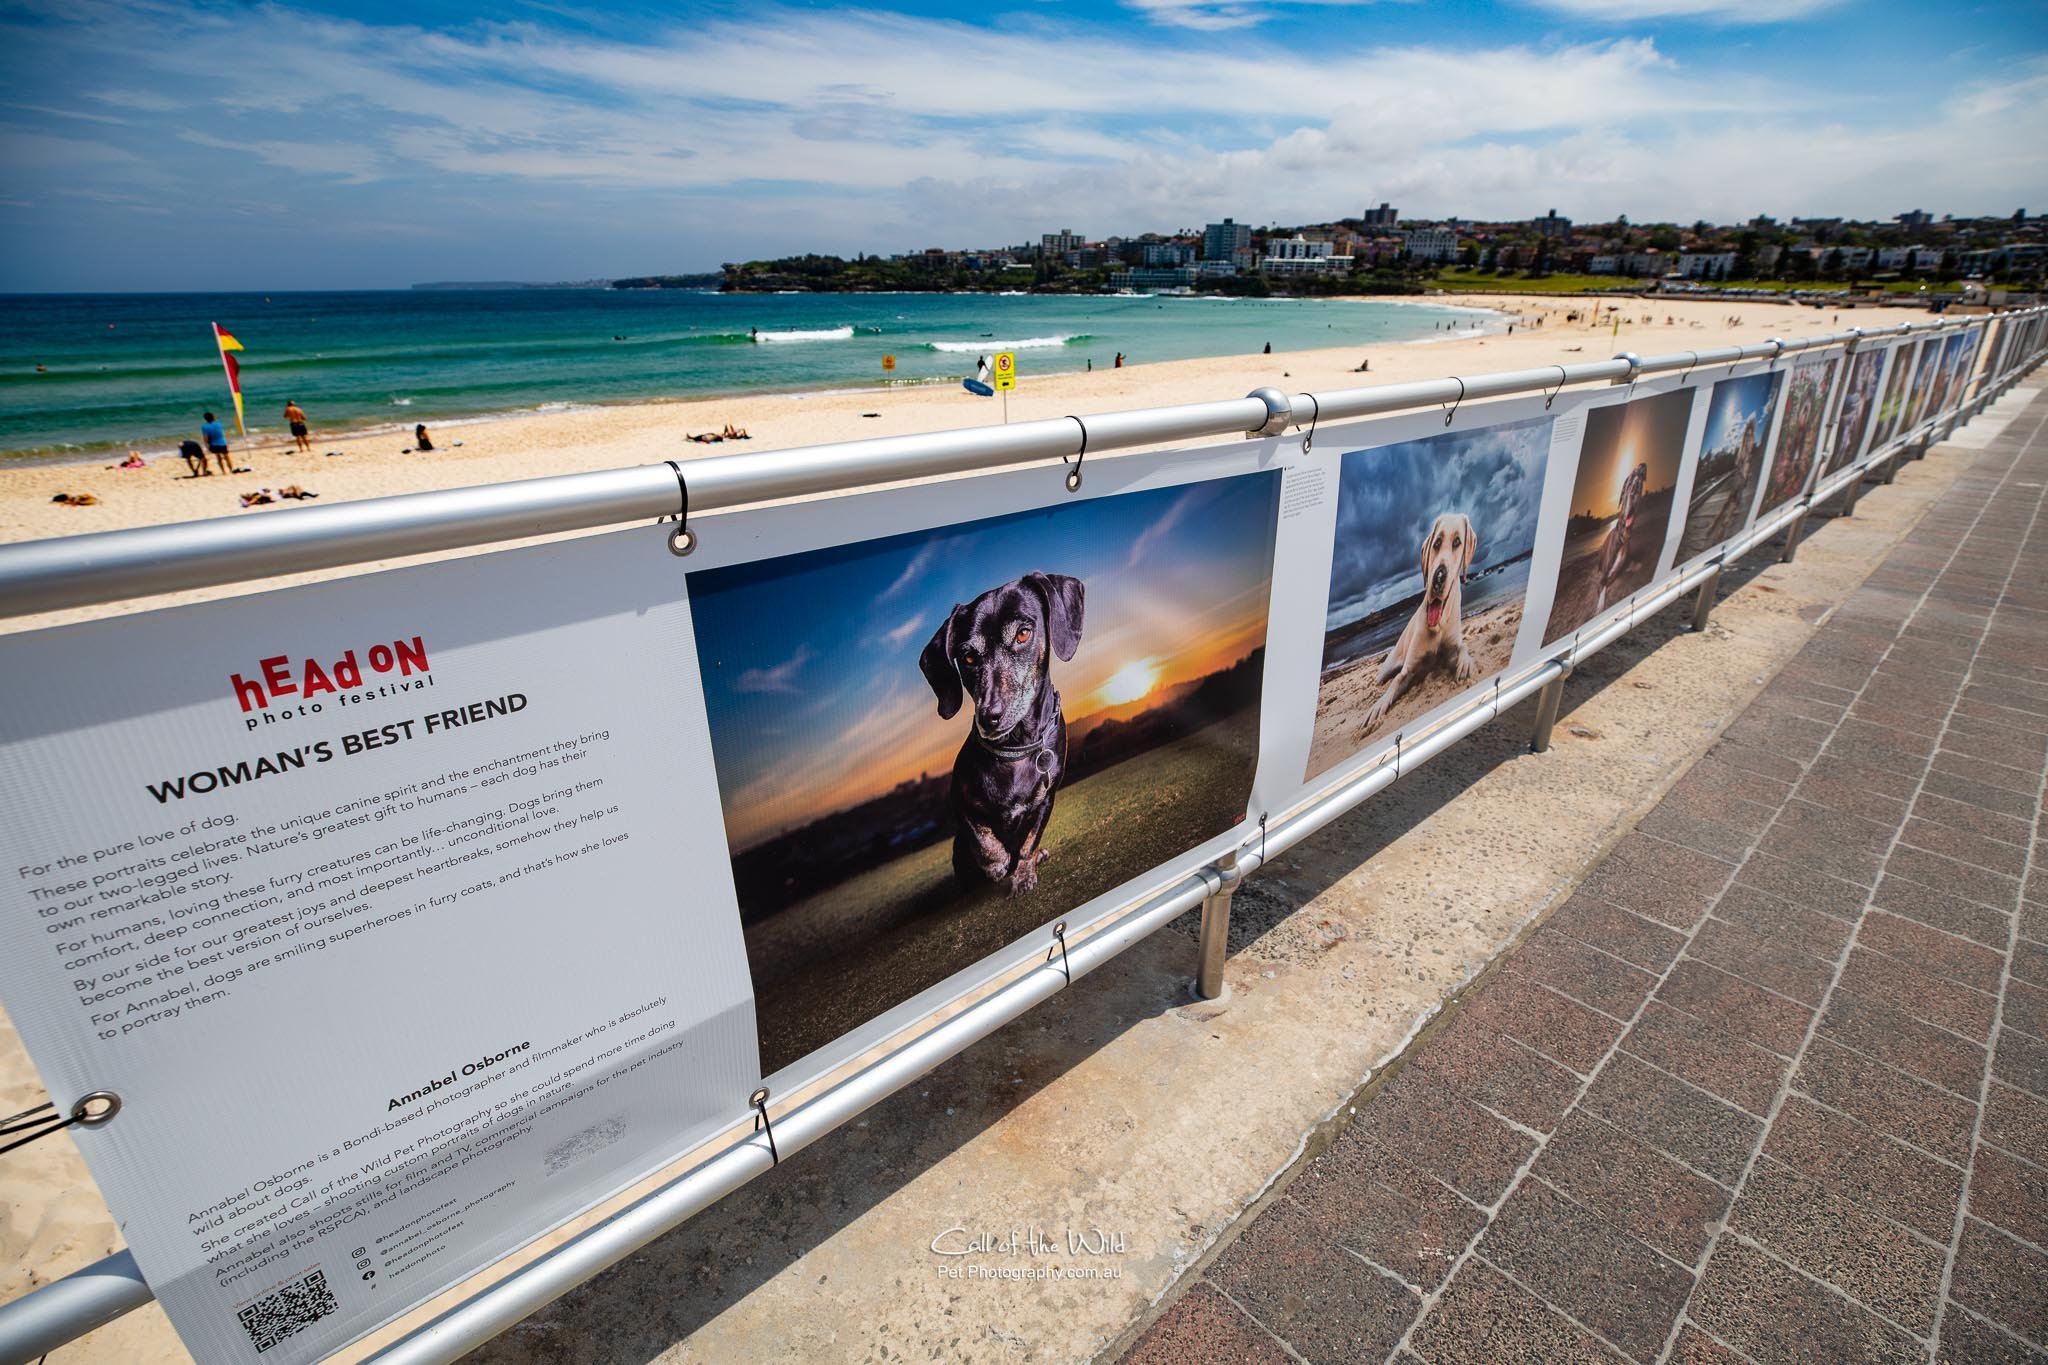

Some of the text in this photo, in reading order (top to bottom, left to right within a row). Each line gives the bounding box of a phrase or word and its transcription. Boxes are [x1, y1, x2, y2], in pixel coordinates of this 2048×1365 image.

[144, 693, 528, 804] WOMAN'S BEST FRIEND
[244, 674, 434, 732] photo festival
[18, 814, 239, 879] For the pure love of dog.
[27, 730, 610, 901] These portraits celebrate the unique canine spirit and the enchantment they bring
[37, 749, 587, 918] to our two-legged lives. Nature's greatest gift to humans each dog has their
[55, 778, 604, 955] For humans, loving these furry creatures can be life-changing. Dogs bring them
[63, 941, 140, 970] comfort,
[143, 925, 188, 945] deep
[191, 896, 283, 930] connection,
[286, 881, 315, 899] and
[317, 870, 354, 889] most
[447, 811, 530, 847] unconditional
[531, 806, 559, 820] love.
[46, 871, 233, 933] own remarkable story.
[73, 805, 619, 992] By our side for our greatest joys and deepest heartbreaks, somehow they help us
[79, 903, 373, 1006] become the best version of ourselves.
[90, 832, 629, 1026] For Annabel, dogs are smiling superheroes in furry coats, and that's how she loves
[97, 990, 231, 1040] to portray them.
[387, 1041, 530, 1112] Annabel Osborne
[188, 996, 667, 1224] Annabel Osborne is a Bondi-based photographer and filmmaker who is absolutely
[200, 1020, 675, 1253] She created Call of the Wild Pet Photography so she could spend more time doing
[206, 1081, 575, 1264] what she loves shooting custom portraits of dogs in nature.
[192, 1177, 313, 1236] wild about dogs.
